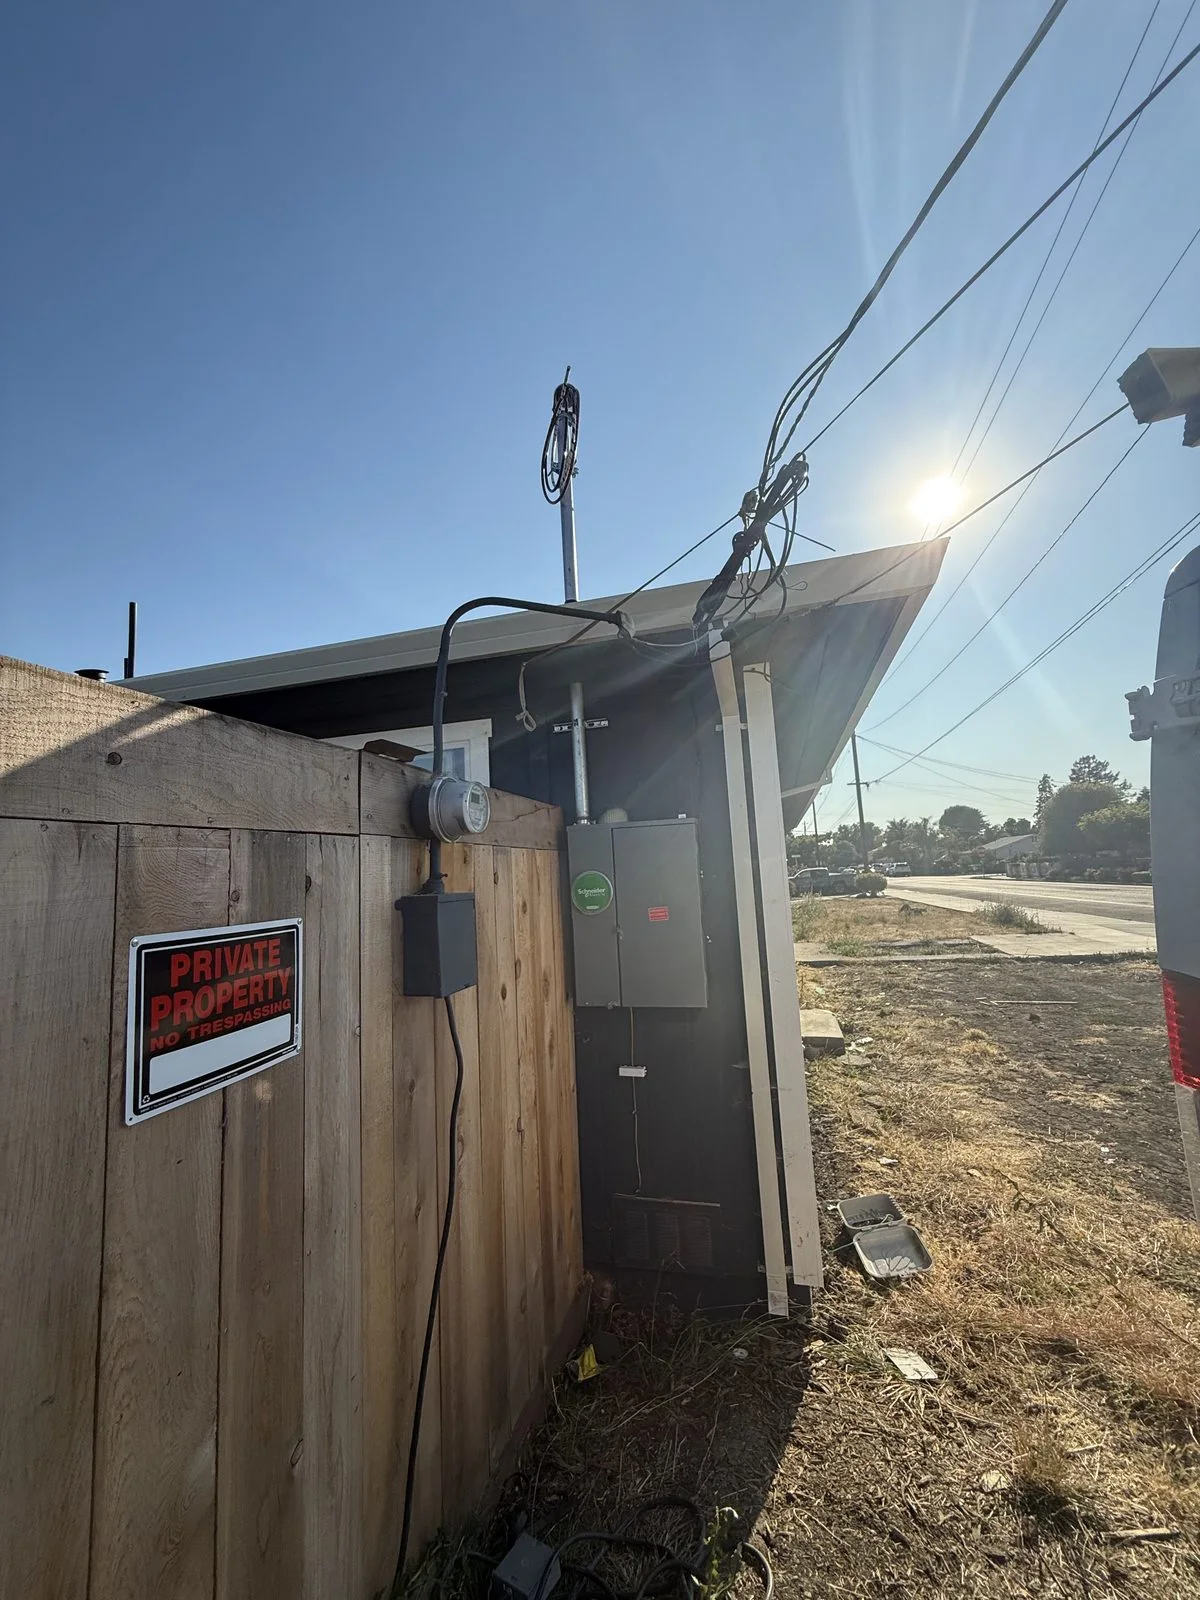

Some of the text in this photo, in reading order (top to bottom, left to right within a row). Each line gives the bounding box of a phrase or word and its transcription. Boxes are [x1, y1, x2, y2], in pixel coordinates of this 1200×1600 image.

[170, 938, 281, 988] PRIVATE
[151, 967, 291, 1031] PROPERTY
[151, 1031, 180, 1052] NO
[187, 999, 291, 1040] TRESPASSING
